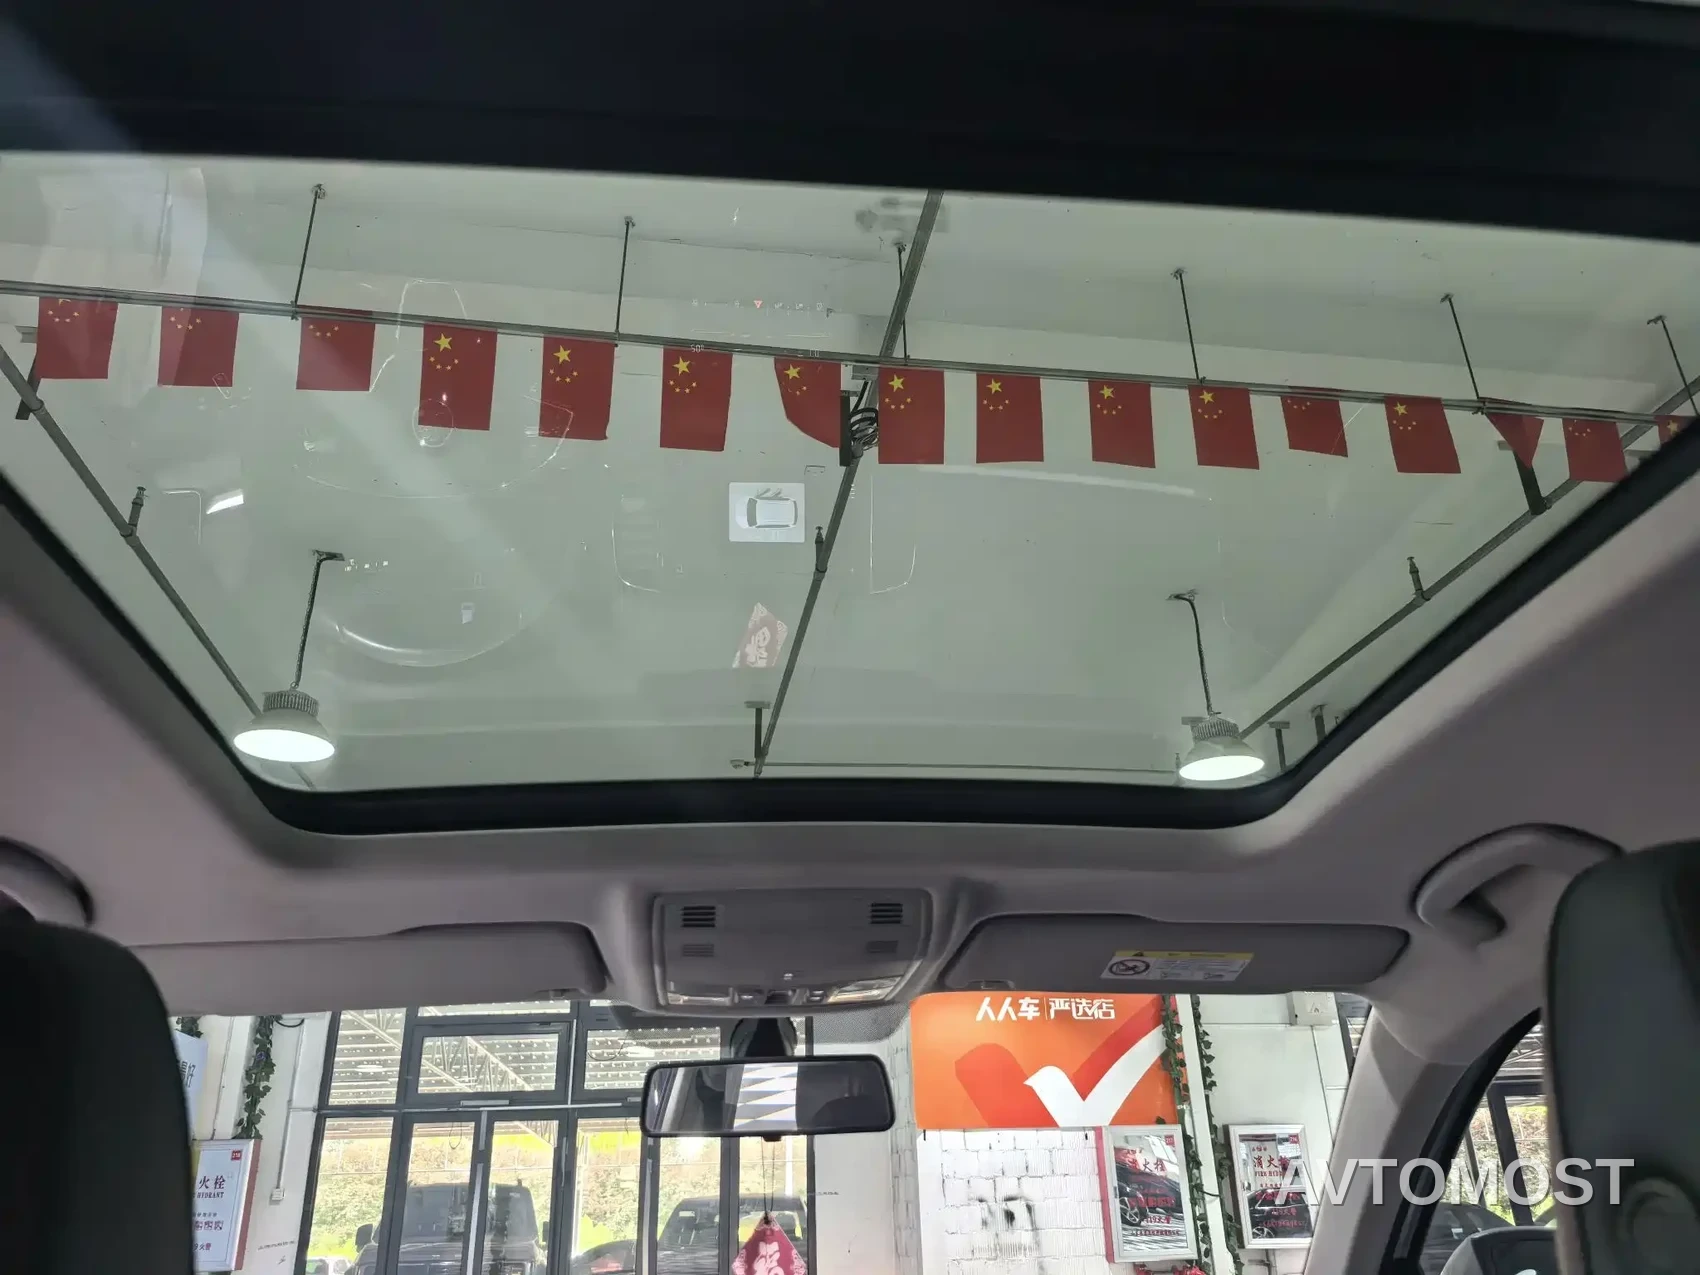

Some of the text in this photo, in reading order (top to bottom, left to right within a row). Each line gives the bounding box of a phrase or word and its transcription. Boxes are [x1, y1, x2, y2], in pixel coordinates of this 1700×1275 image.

[976, 996, 1115, 1022] 人人车 严选店
